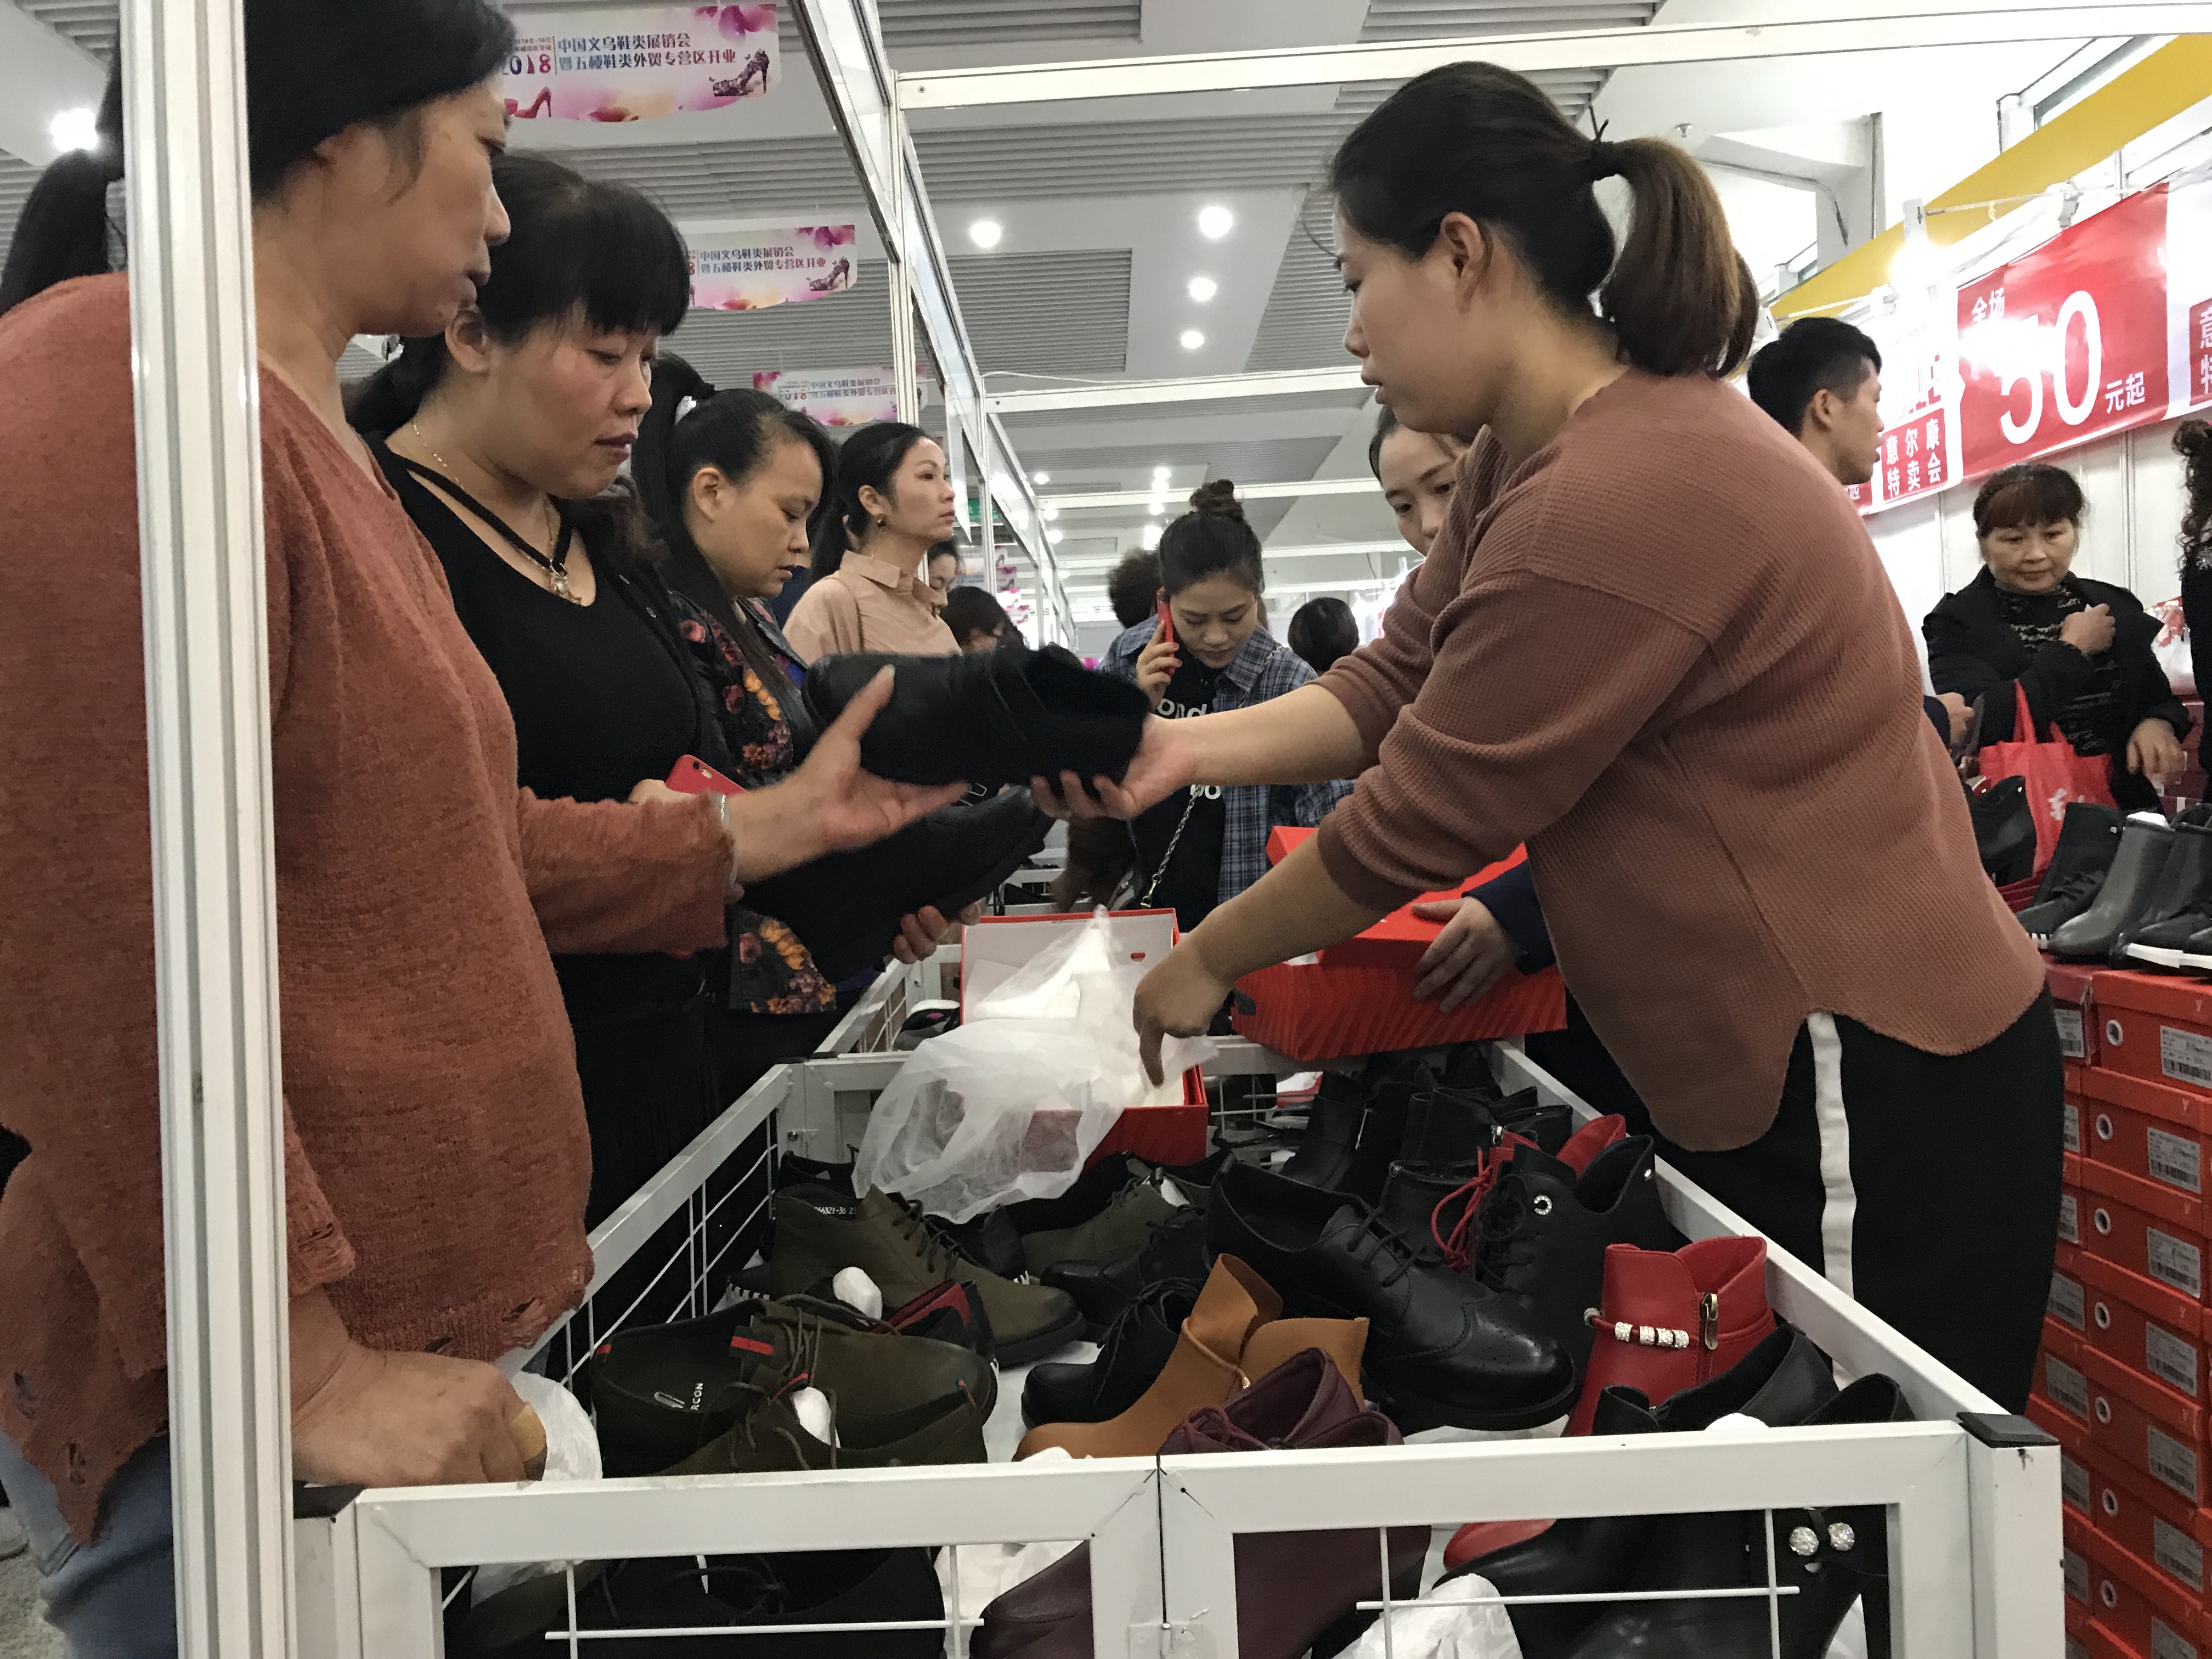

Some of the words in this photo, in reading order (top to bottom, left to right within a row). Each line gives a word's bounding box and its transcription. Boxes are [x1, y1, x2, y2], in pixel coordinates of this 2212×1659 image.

[503, 54, 551, 75] 018
[2105, 371, 2146, 415] 元起
[1886, 417, 1940, 466] 意尔康
[1887, 452, 1941, 498] 特卖会
